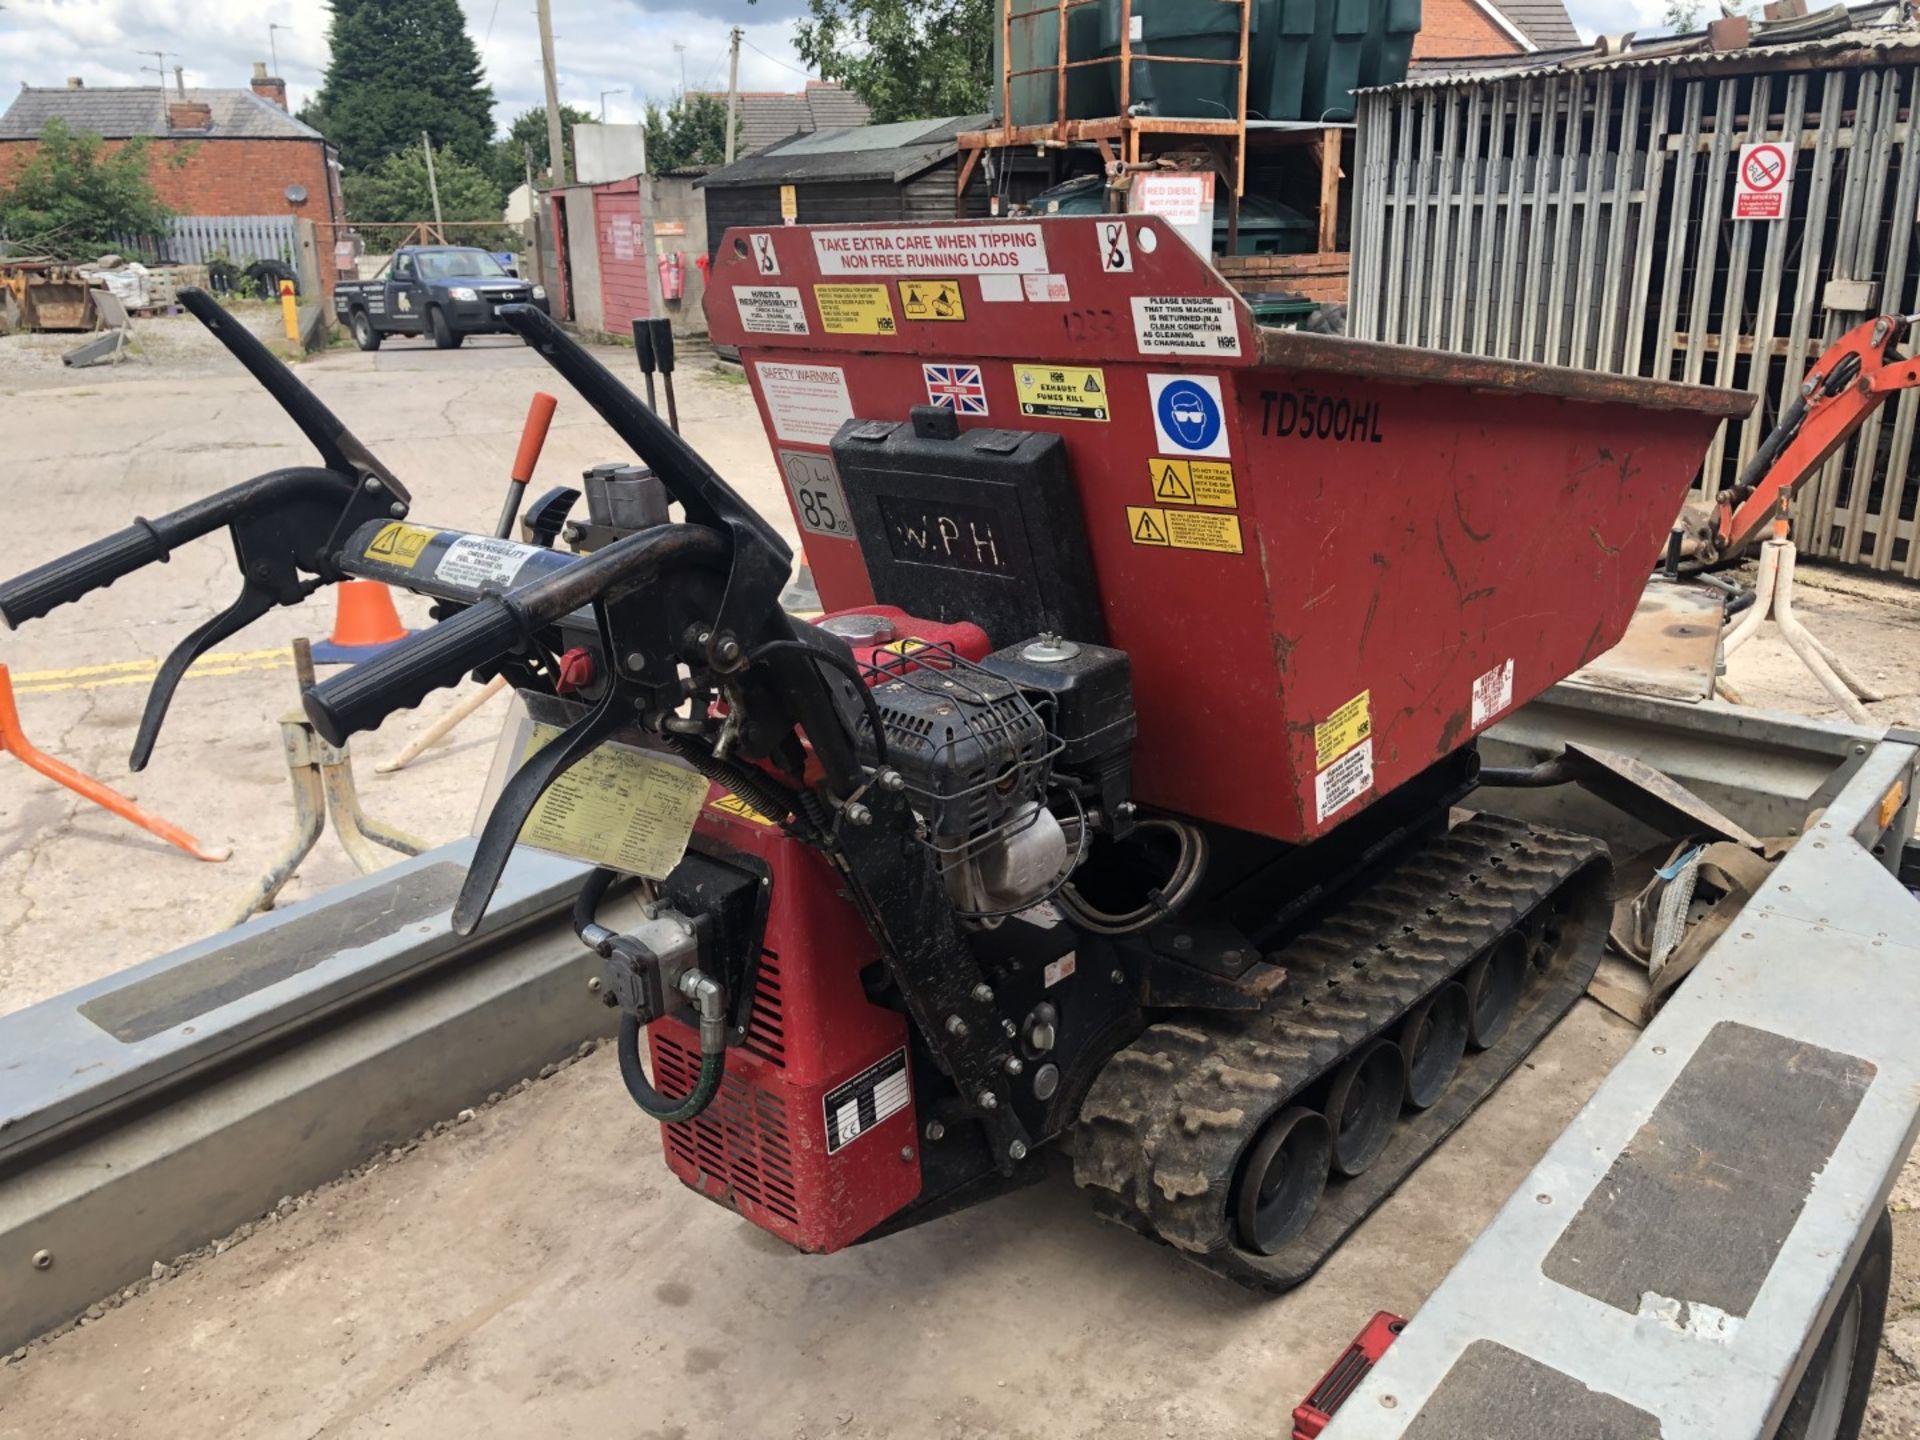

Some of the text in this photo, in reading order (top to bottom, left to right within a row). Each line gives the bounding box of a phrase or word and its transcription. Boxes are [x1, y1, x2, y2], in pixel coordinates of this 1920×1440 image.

[1147, 187, 1197, 195] RED DIESEL
[819, 232, 1037, 251] TAKE EXTRA CARE WHEN TIPPING
[841, 251, 1020, 268] NON FREE RUNNING LOADS
[739, 298, 798, 308] RESPONSIBILITY
[1185, 306, 1222, 314] MACHINE
[1203, 315, 1212, 323] IN
[1177, 323, 1222, 331] CONDITION
[1154, 339, 1206, 348] CHARGEABLE
[761, 366, 840, 384] SAFETY WARNING
[1040, 383, 1077, 392] EXHAUST
[1036, 392, 1084, 403] FUMES KILL
[1260, 390, 1383, 443] TD500HL
[800, 488, 836, 530] 85
[460, 540, 526, 559] RESPONSIBILITY
[467, 550, 485, 558] CHECK
[842, 1121, 858, 1140] CE
